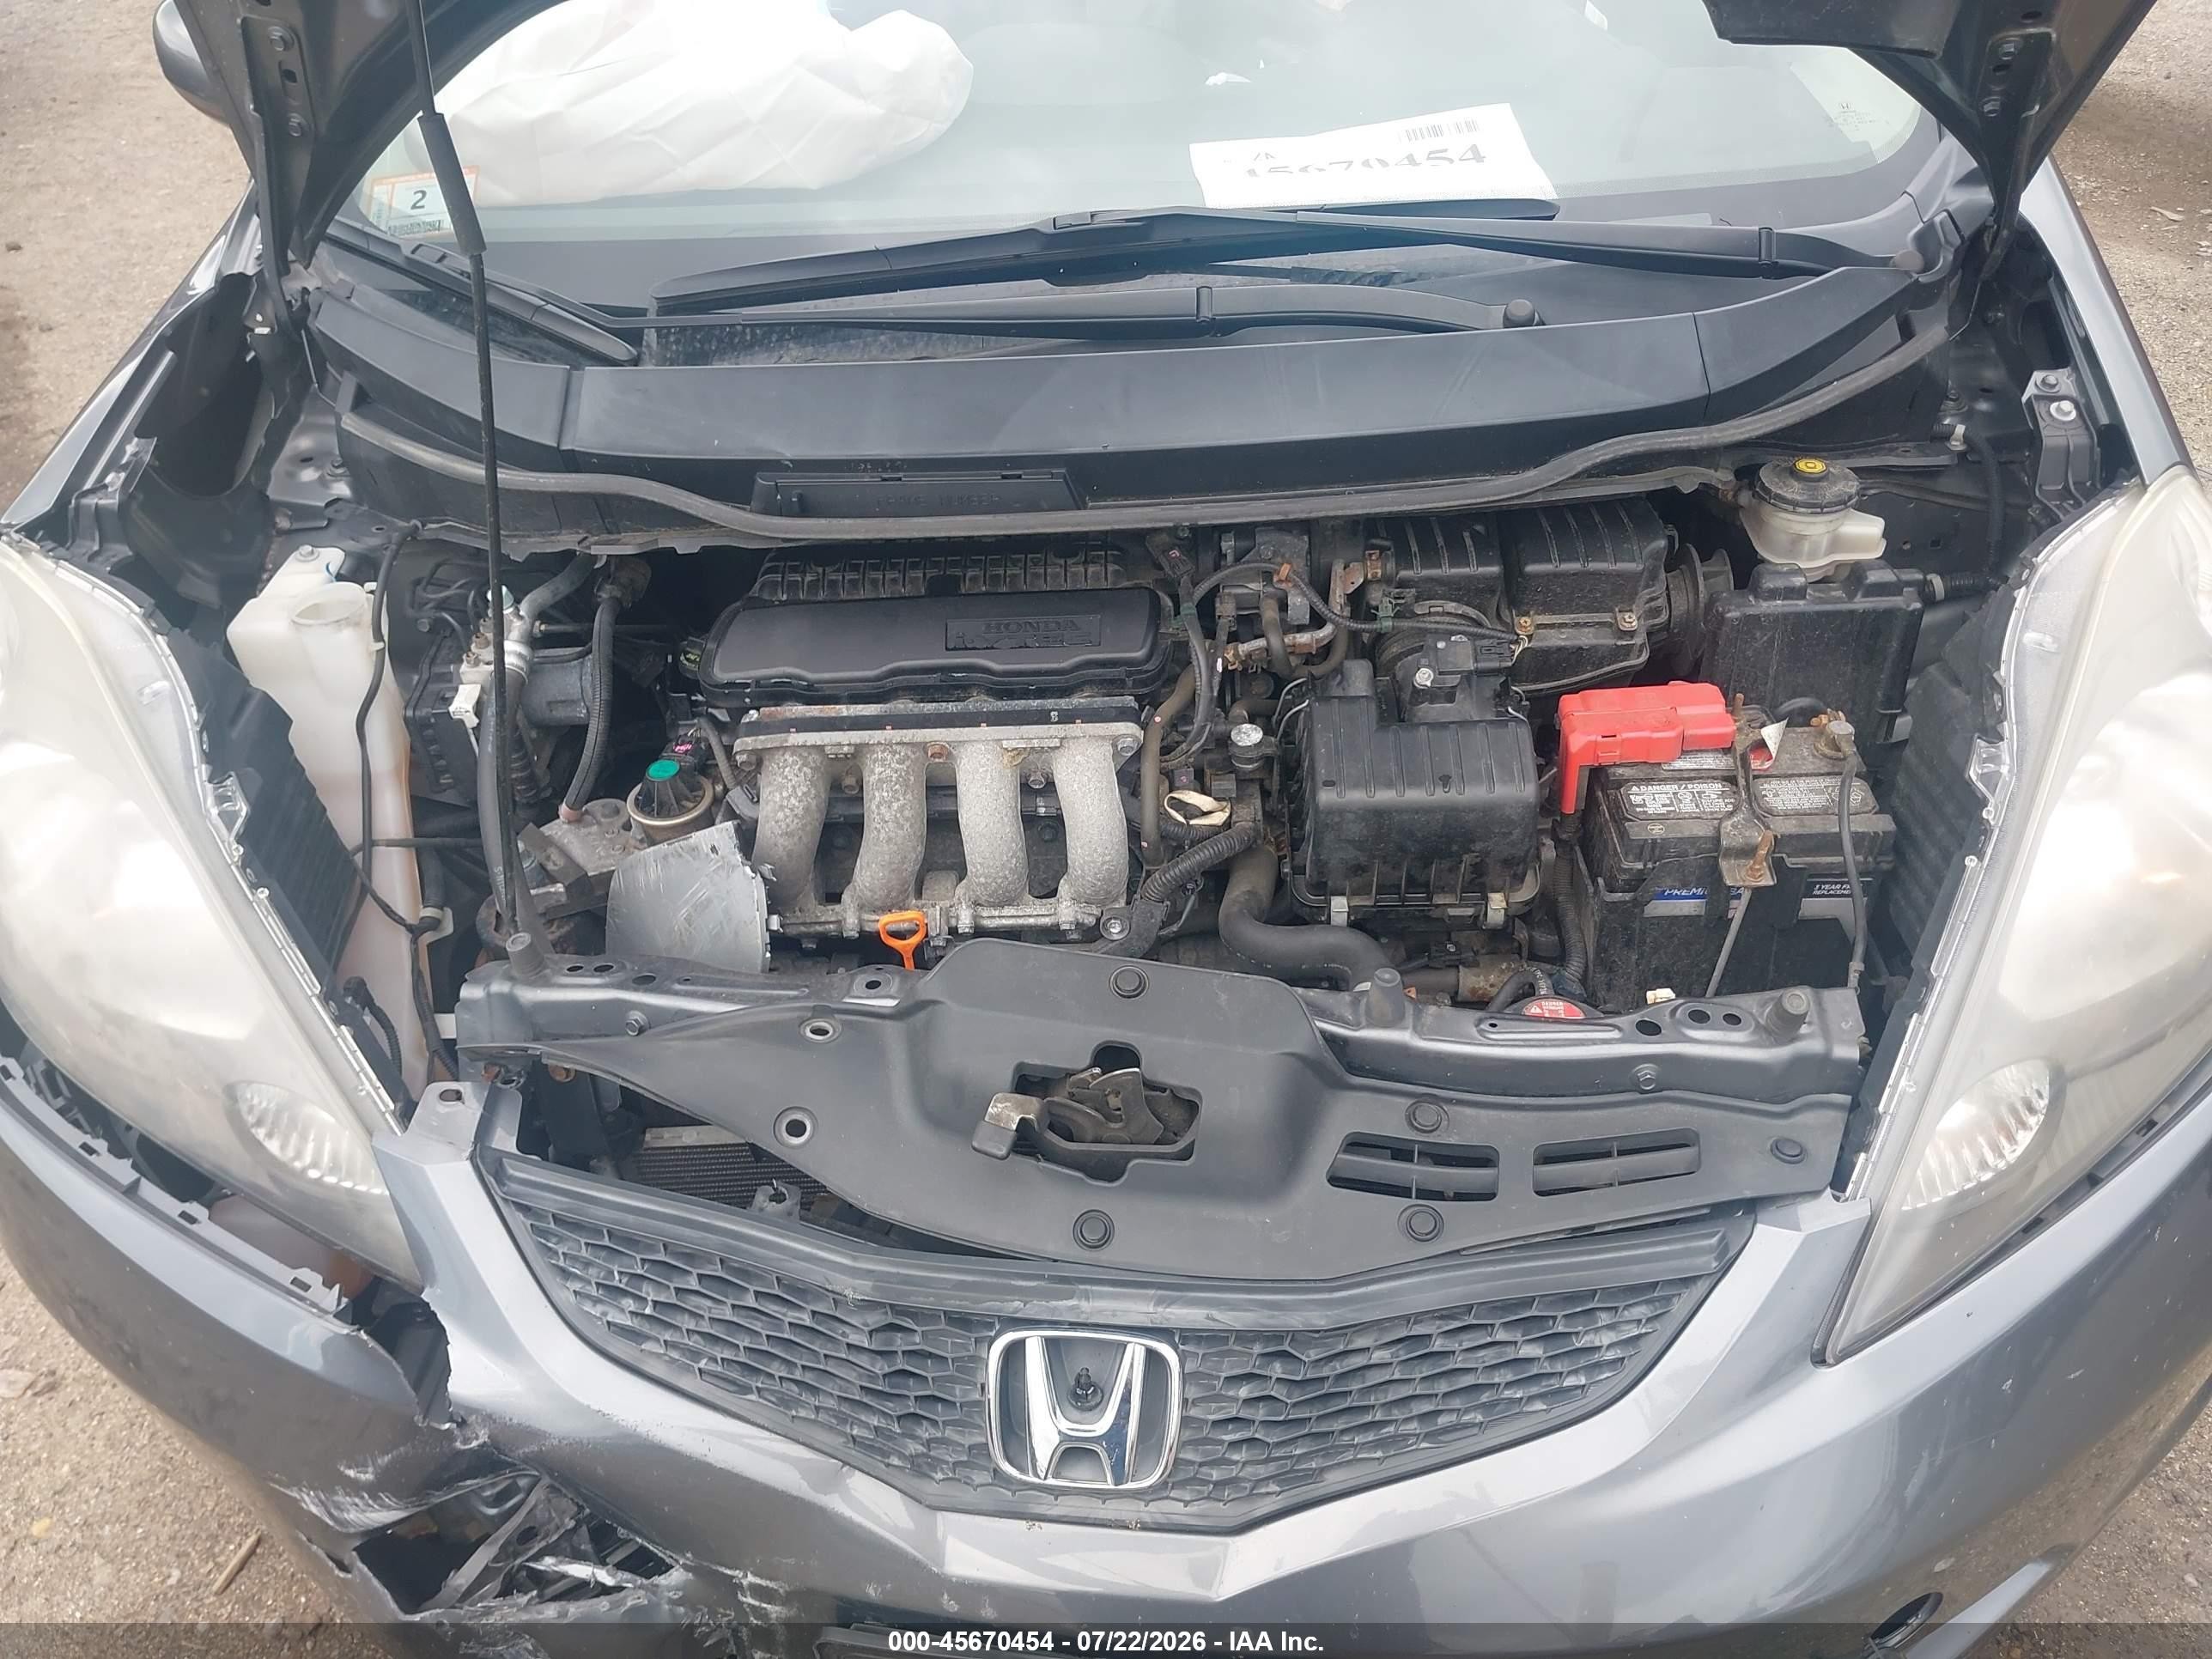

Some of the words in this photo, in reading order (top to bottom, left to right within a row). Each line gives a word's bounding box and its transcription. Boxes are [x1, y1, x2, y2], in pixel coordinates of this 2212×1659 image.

[410, 189, 428, 211] 2
[983, 620, 1081, 634] HONDA
[1640, 783, 1679, 792] DANGER
